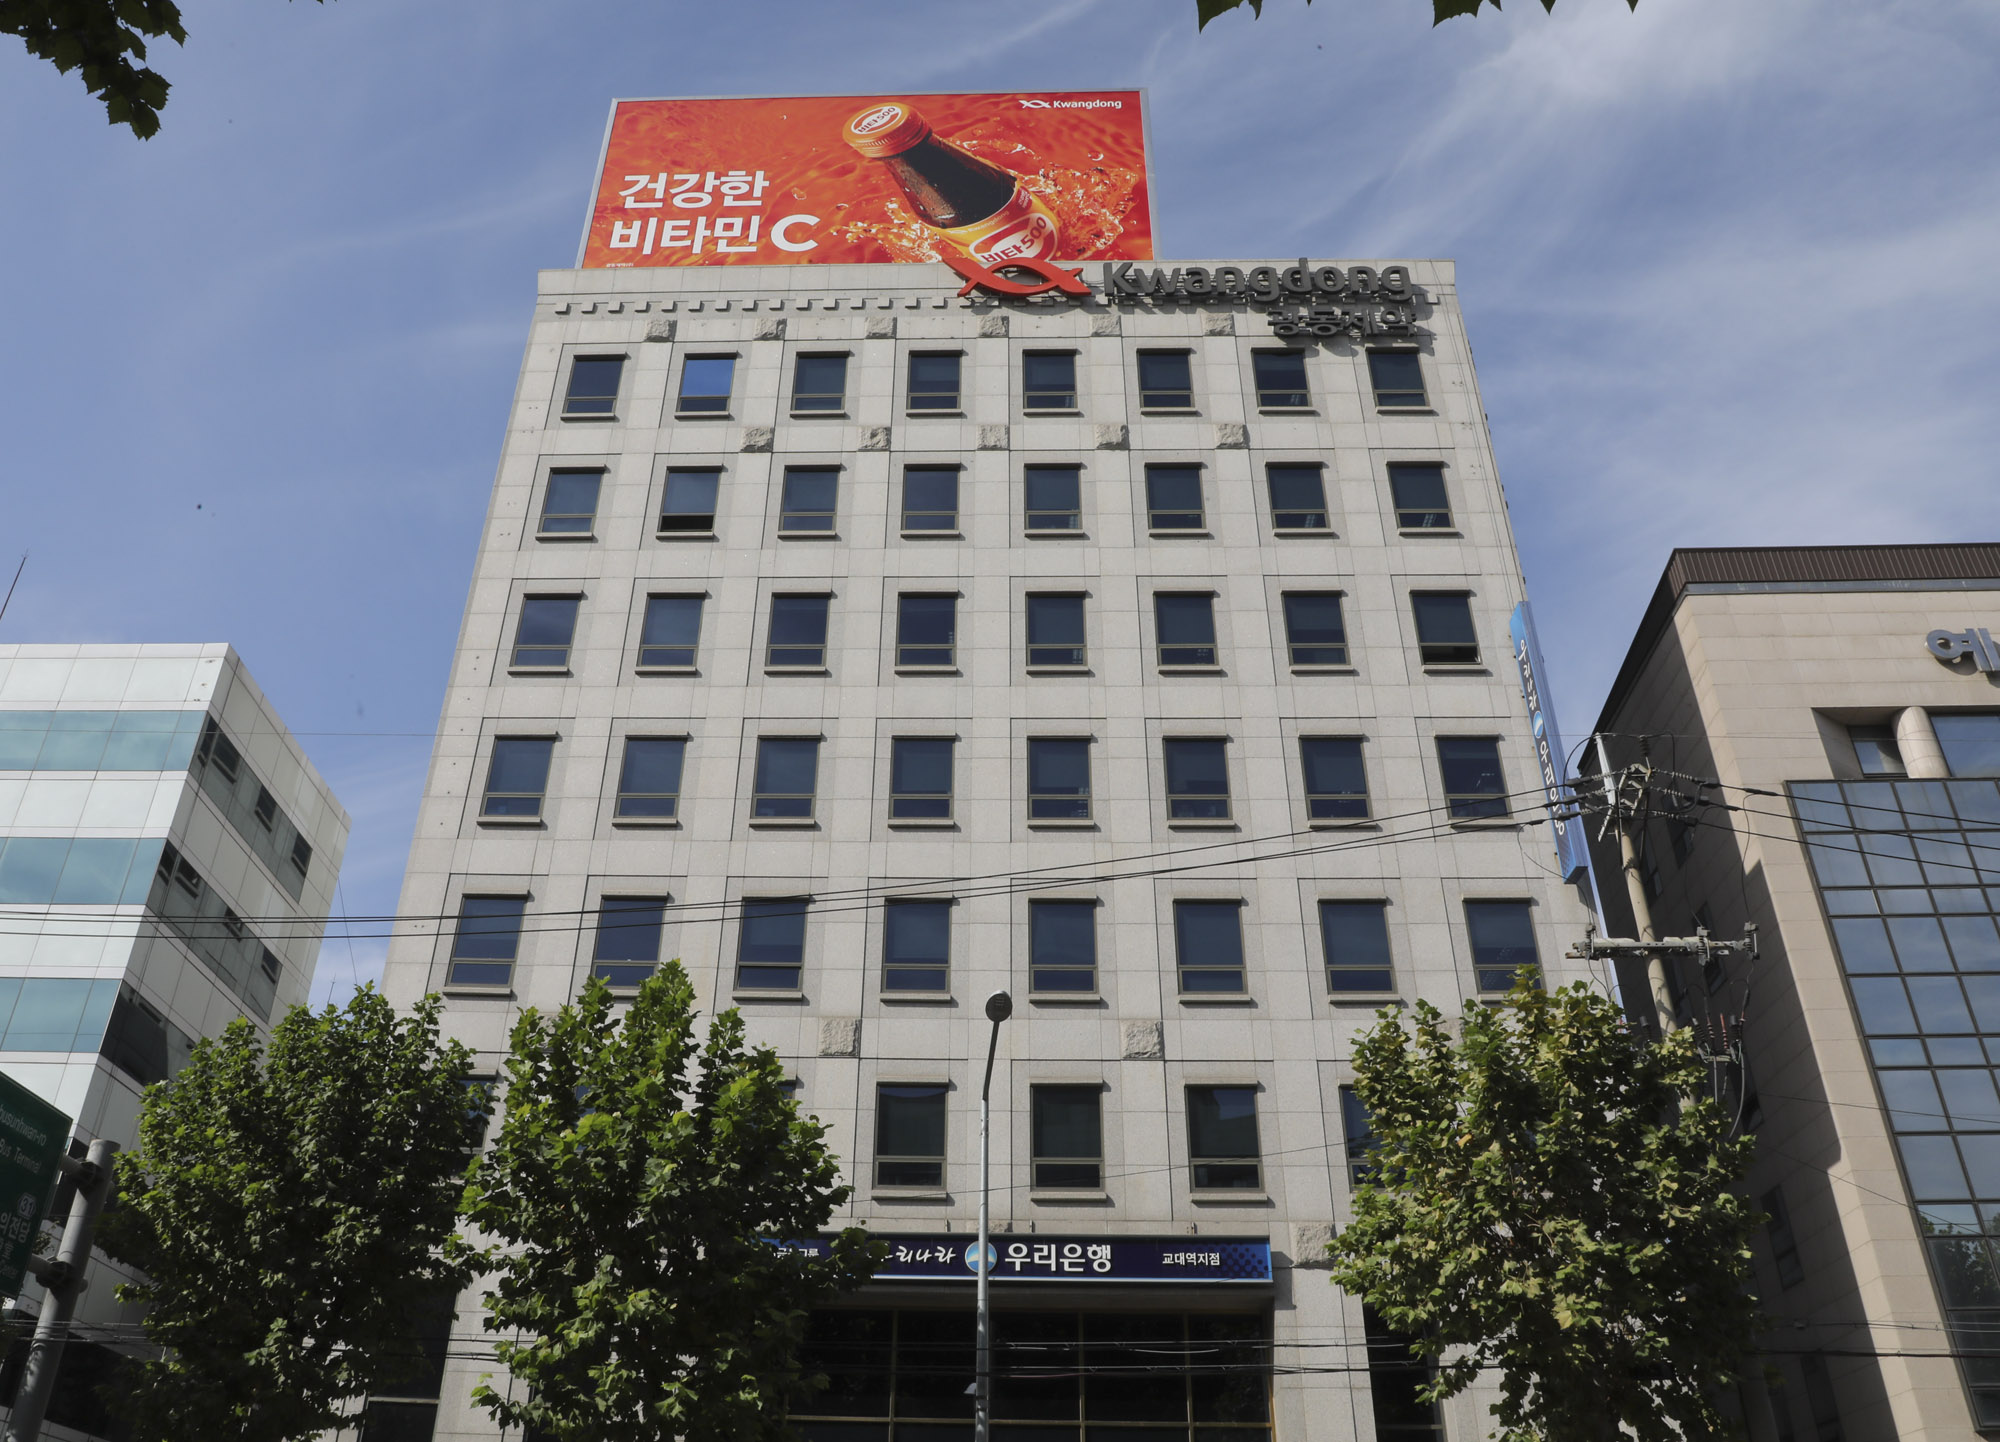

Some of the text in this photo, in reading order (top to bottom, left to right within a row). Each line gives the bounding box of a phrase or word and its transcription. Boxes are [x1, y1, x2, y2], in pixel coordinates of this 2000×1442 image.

[1053, 99, 1122, 110] Kwangdong
[618, 170, 770, 209] 건강한
[609, 214, 821, 255] 비타민 C
[980, 216, 1047, 262] 비타500
[1103, 257, 1413, 303] Kwangdong
[1267, 308, 1417, 337] 광동제약
[1005, 1243, 1111, 1273] 우리은행
[1162, 1252, 1220, 1266] 교대역지점
